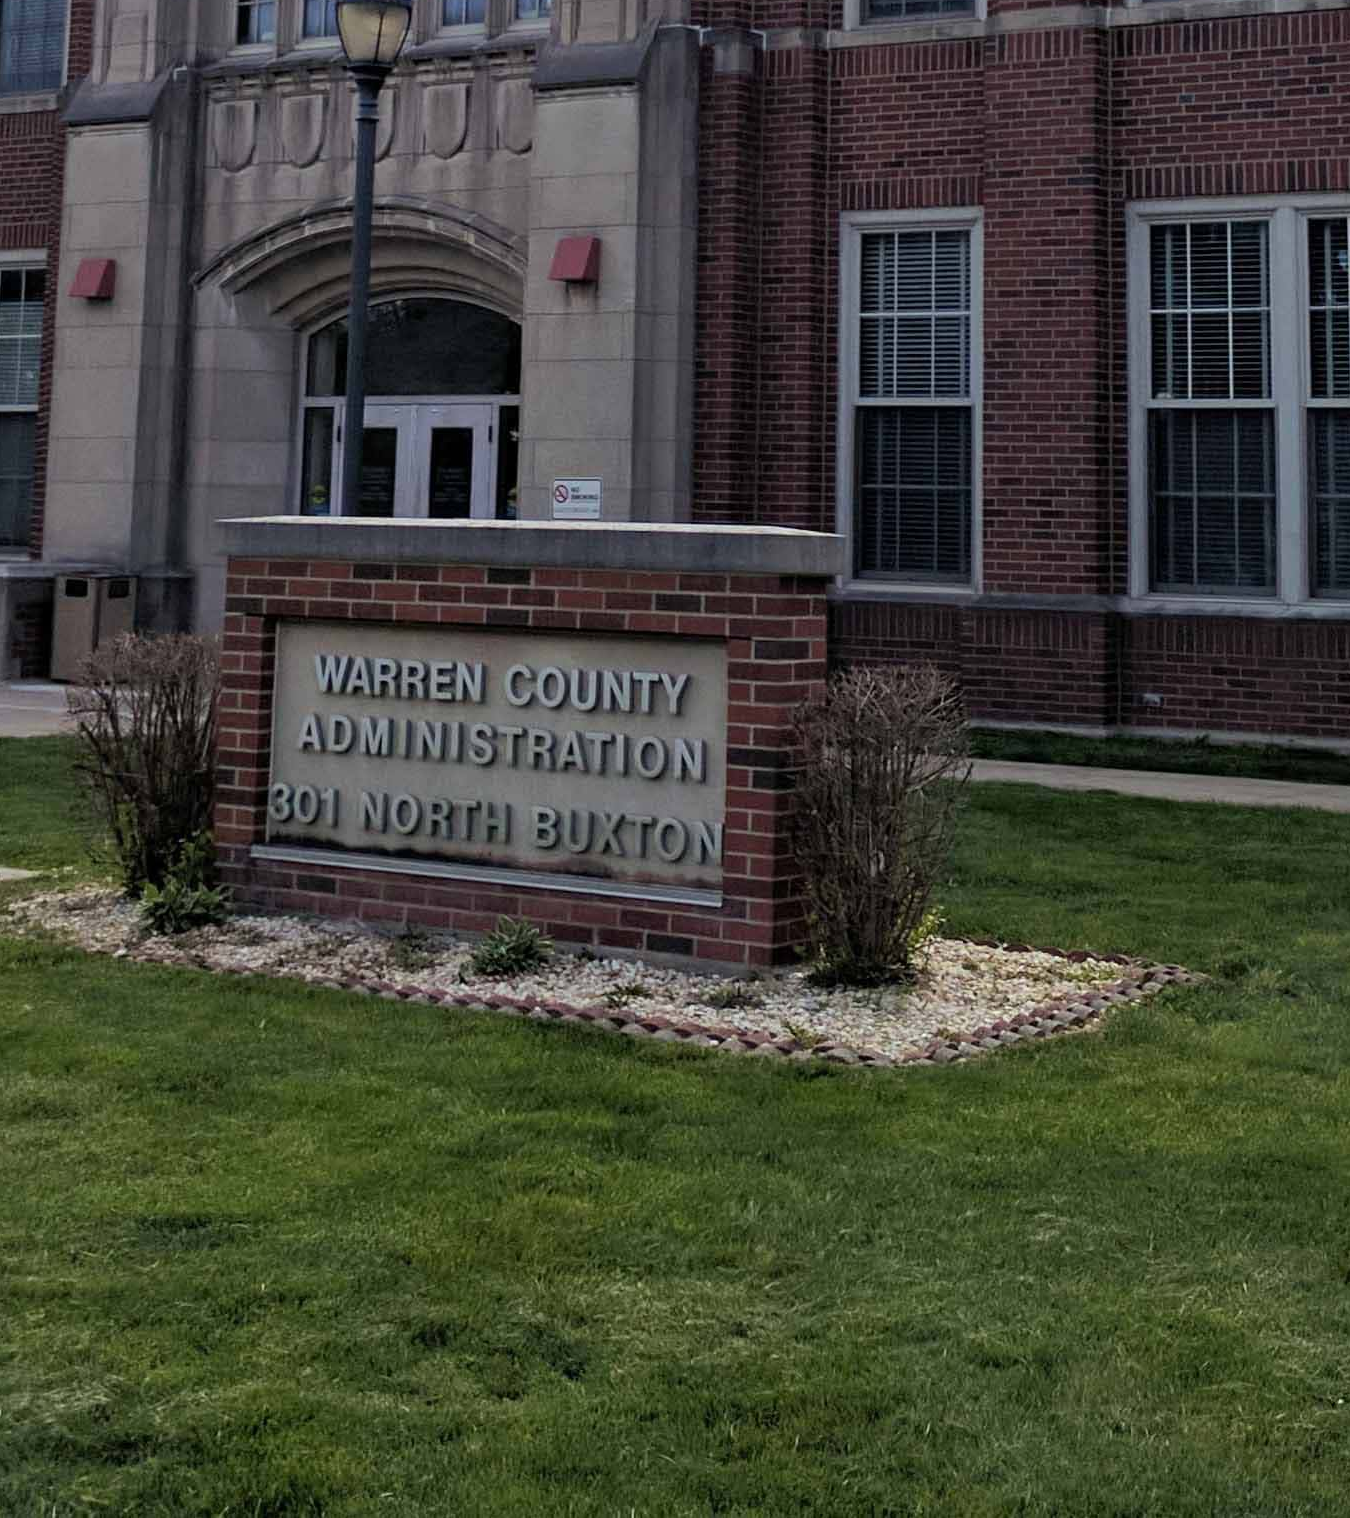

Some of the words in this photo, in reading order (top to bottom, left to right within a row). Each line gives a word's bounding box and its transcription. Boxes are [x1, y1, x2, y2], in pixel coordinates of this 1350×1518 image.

[314, 653, 485, 704] WARREN
[505, 663, 689, 715] COUNTY
[298, 713, 706, 781] ADMINISTRATION
[269, 783, 339, 827] 301
[359, 791, 511, 843] NORTH
[531, 805, 724, 866] BUXTON
